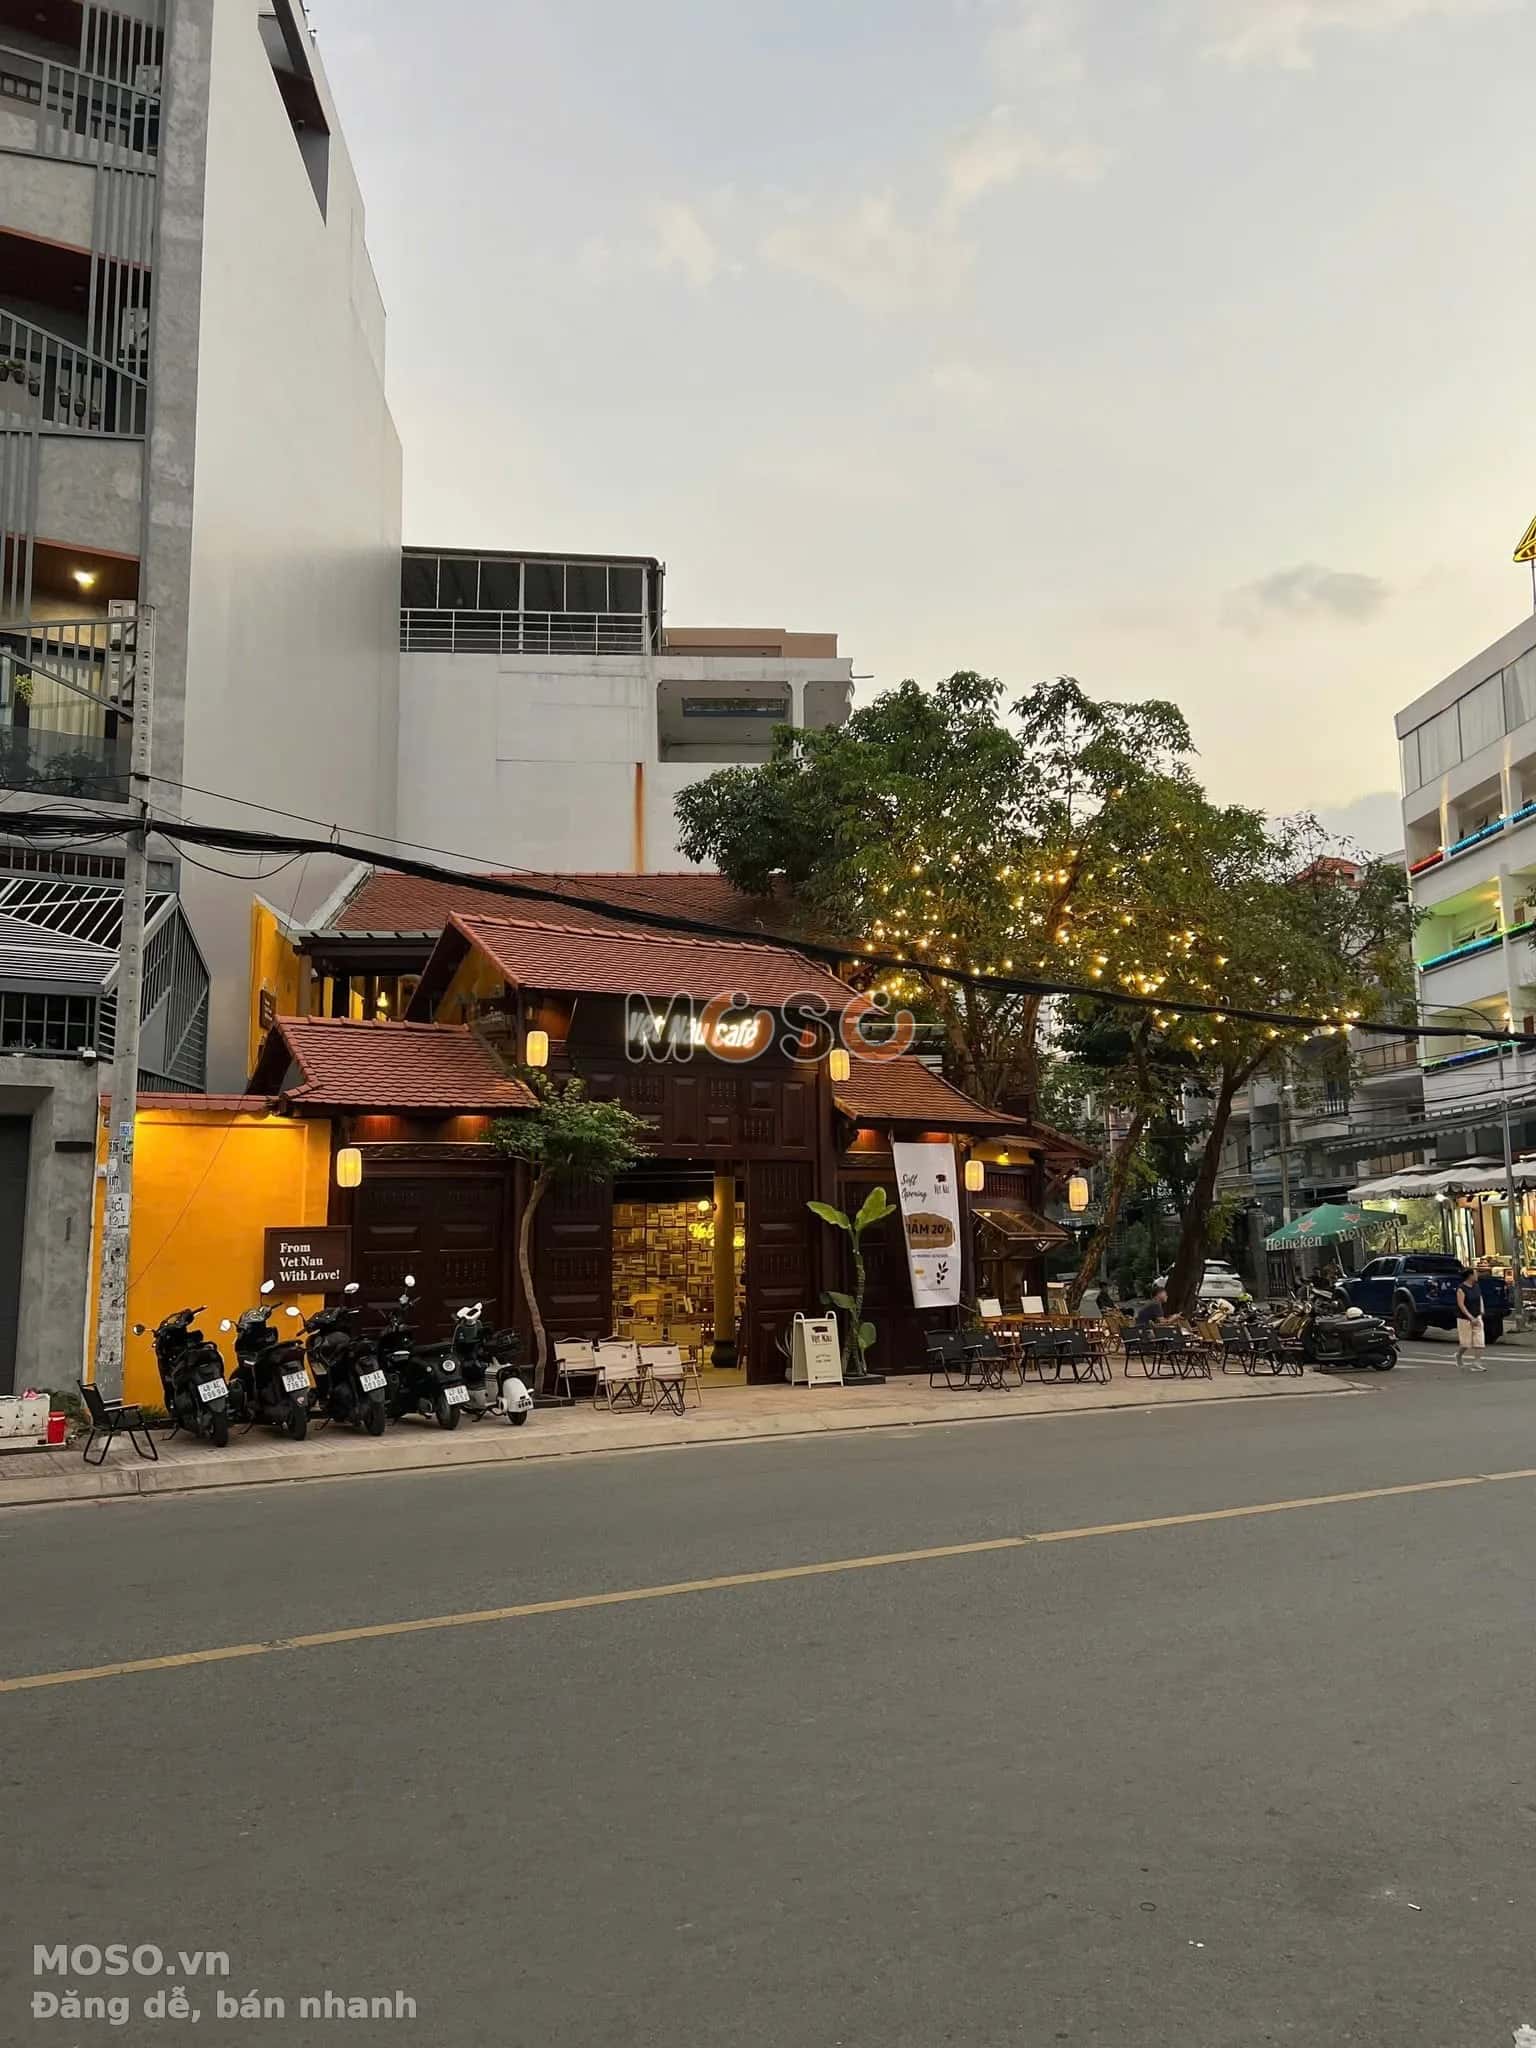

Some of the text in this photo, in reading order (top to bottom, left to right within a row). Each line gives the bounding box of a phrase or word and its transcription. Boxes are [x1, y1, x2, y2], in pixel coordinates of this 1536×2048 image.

[1337, 1217, 1401, 1242] Heineken
[280, 1243, 311, 1253] From
[1265, 1235, 1323, 1252] Heineken
[280, 1255, 323, 1268] Vet Nau
[280, 1269, 340, 1282] With Love!
